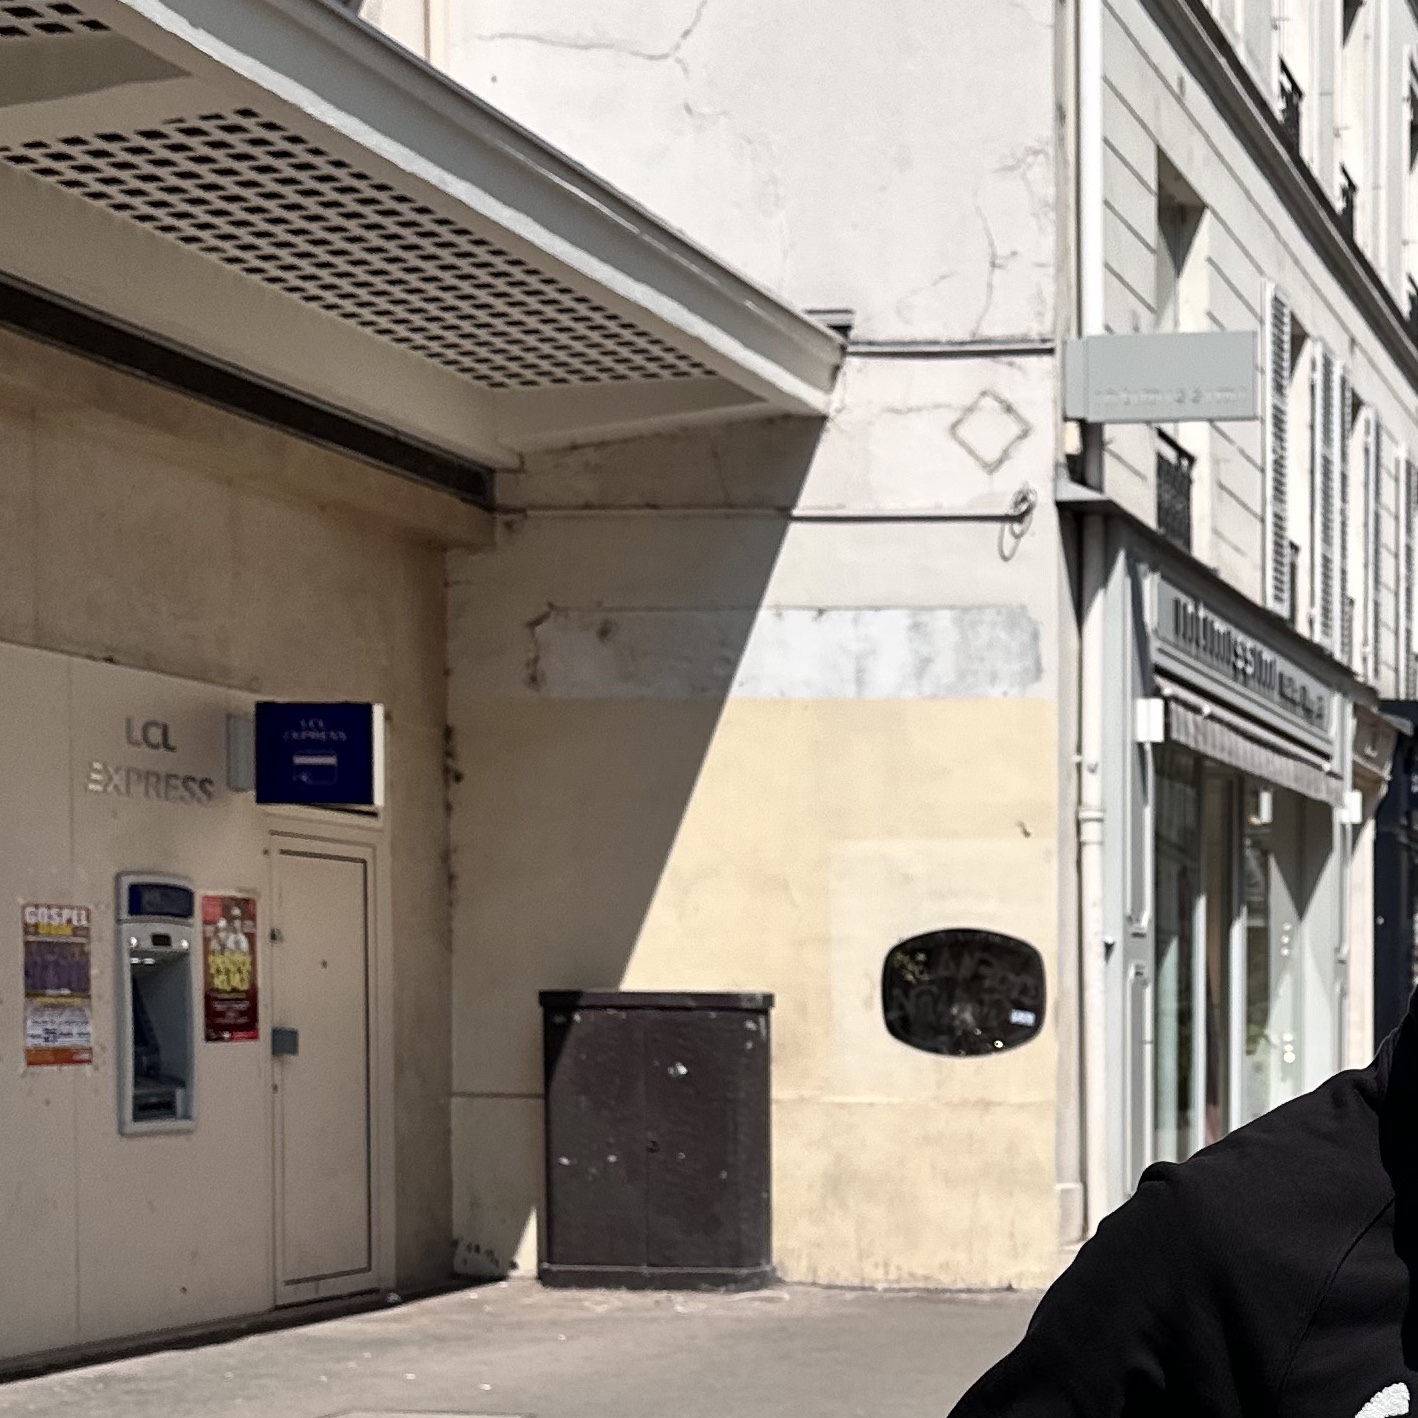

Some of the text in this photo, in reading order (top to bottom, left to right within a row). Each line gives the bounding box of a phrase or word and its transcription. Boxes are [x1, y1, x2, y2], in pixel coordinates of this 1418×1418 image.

[125, 716, 177, 753] LCL
[84, 761, 214, 803] EXPRESS
[25, 906, 88, 926] GOSPEL
